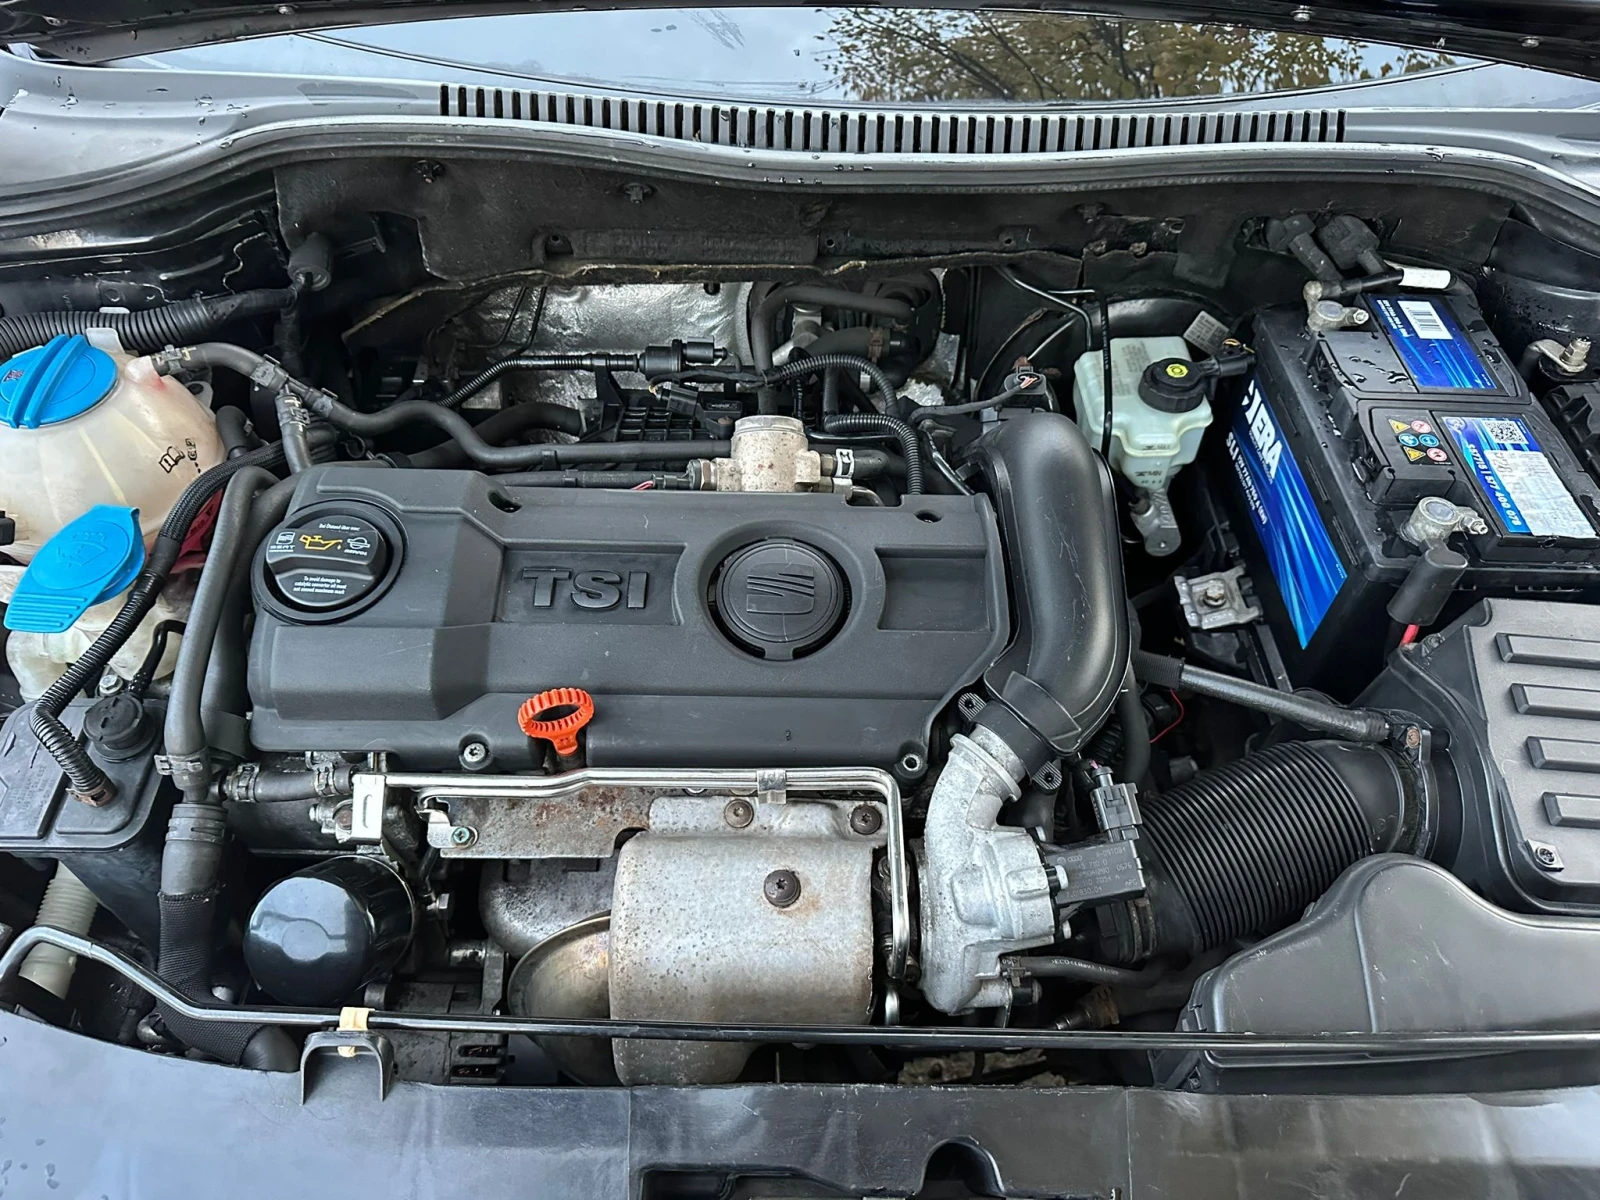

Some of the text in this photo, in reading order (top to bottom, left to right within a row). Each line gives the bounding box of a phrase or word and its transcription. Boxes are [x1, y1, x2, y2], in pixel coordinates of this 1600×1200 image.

[1485, 475, 1501, 491] 577
[1494, 491, 1512, 509] 400
[1505, 510, 1522, 526] 078
[522, 567, 650, 611] TSI
